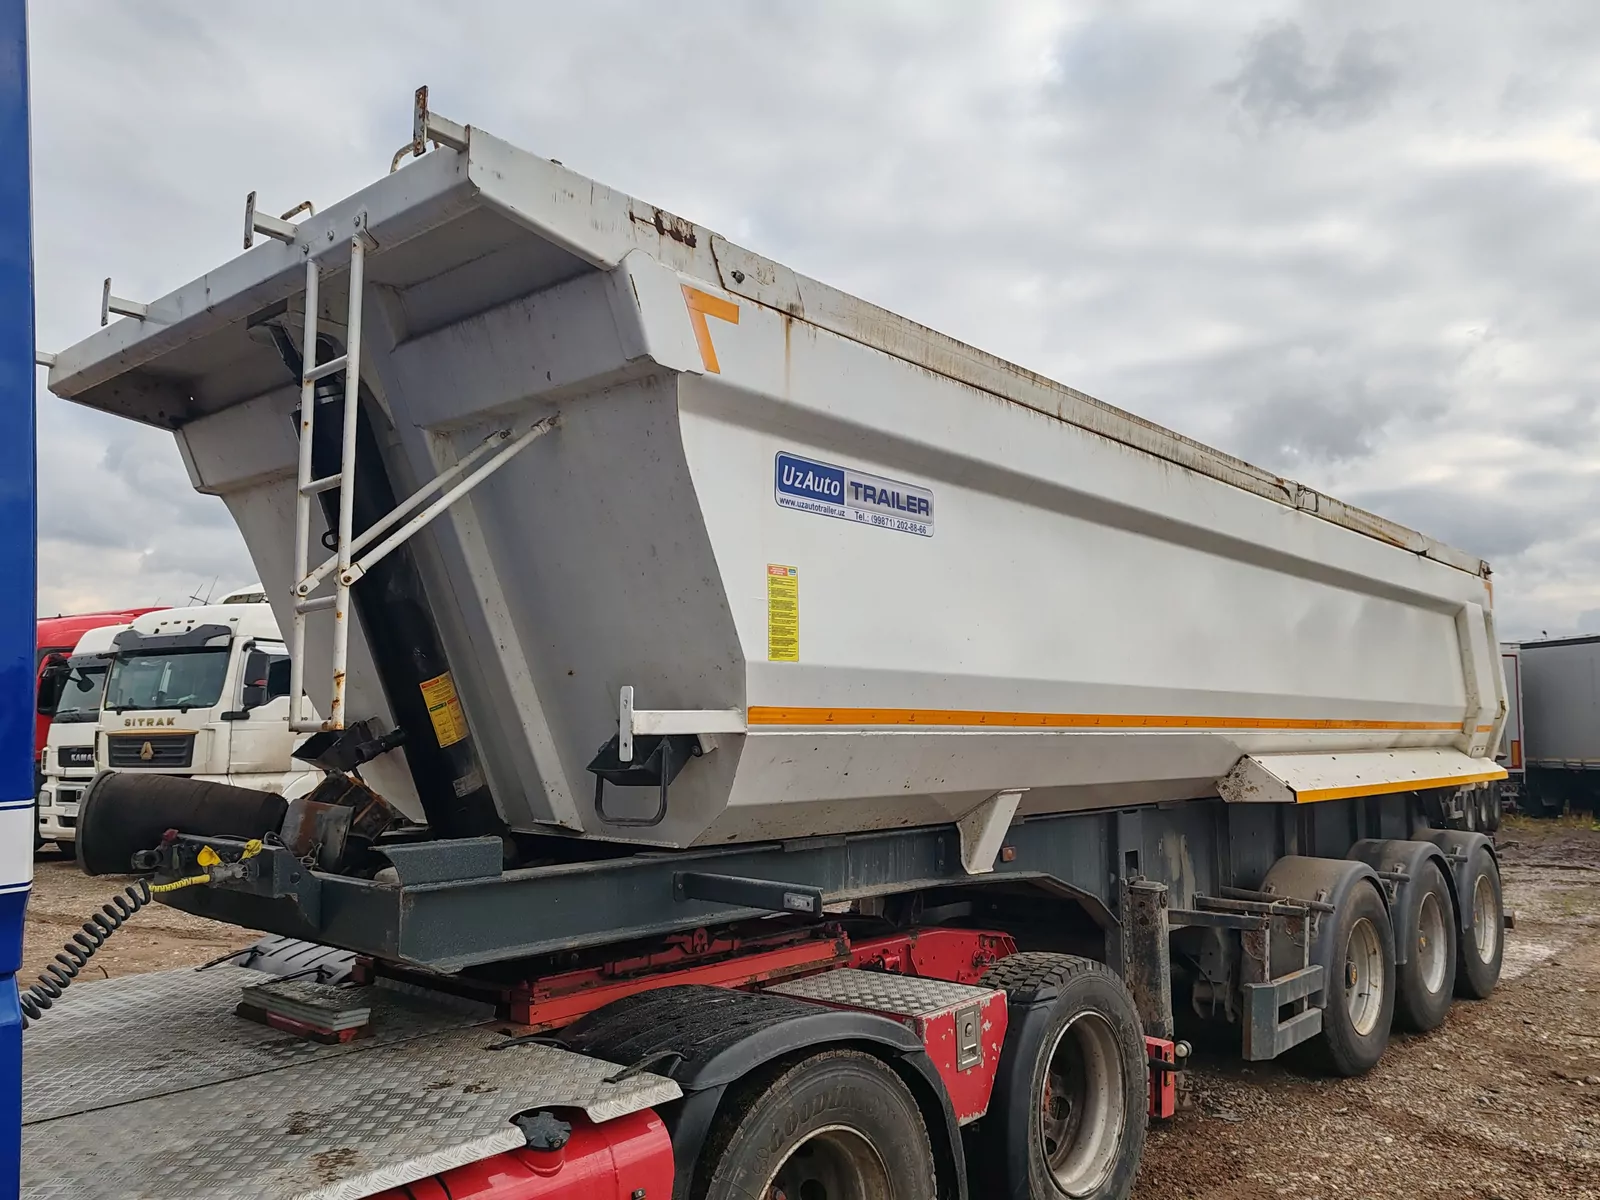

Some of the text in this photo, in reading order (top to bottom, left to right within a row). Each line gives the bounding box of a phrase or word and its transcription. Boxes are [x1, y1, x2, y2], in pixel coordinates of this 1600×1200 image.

[782, 464, 929, 517] UzAuto TRAILER
[779, 497, 846, 517] www.uzautotrailer.uz
[871, 514, 896, 528] (99871)
[897, 520, 927, 535] 202-88-66
[124, 717, 176, 727] SITRAK
